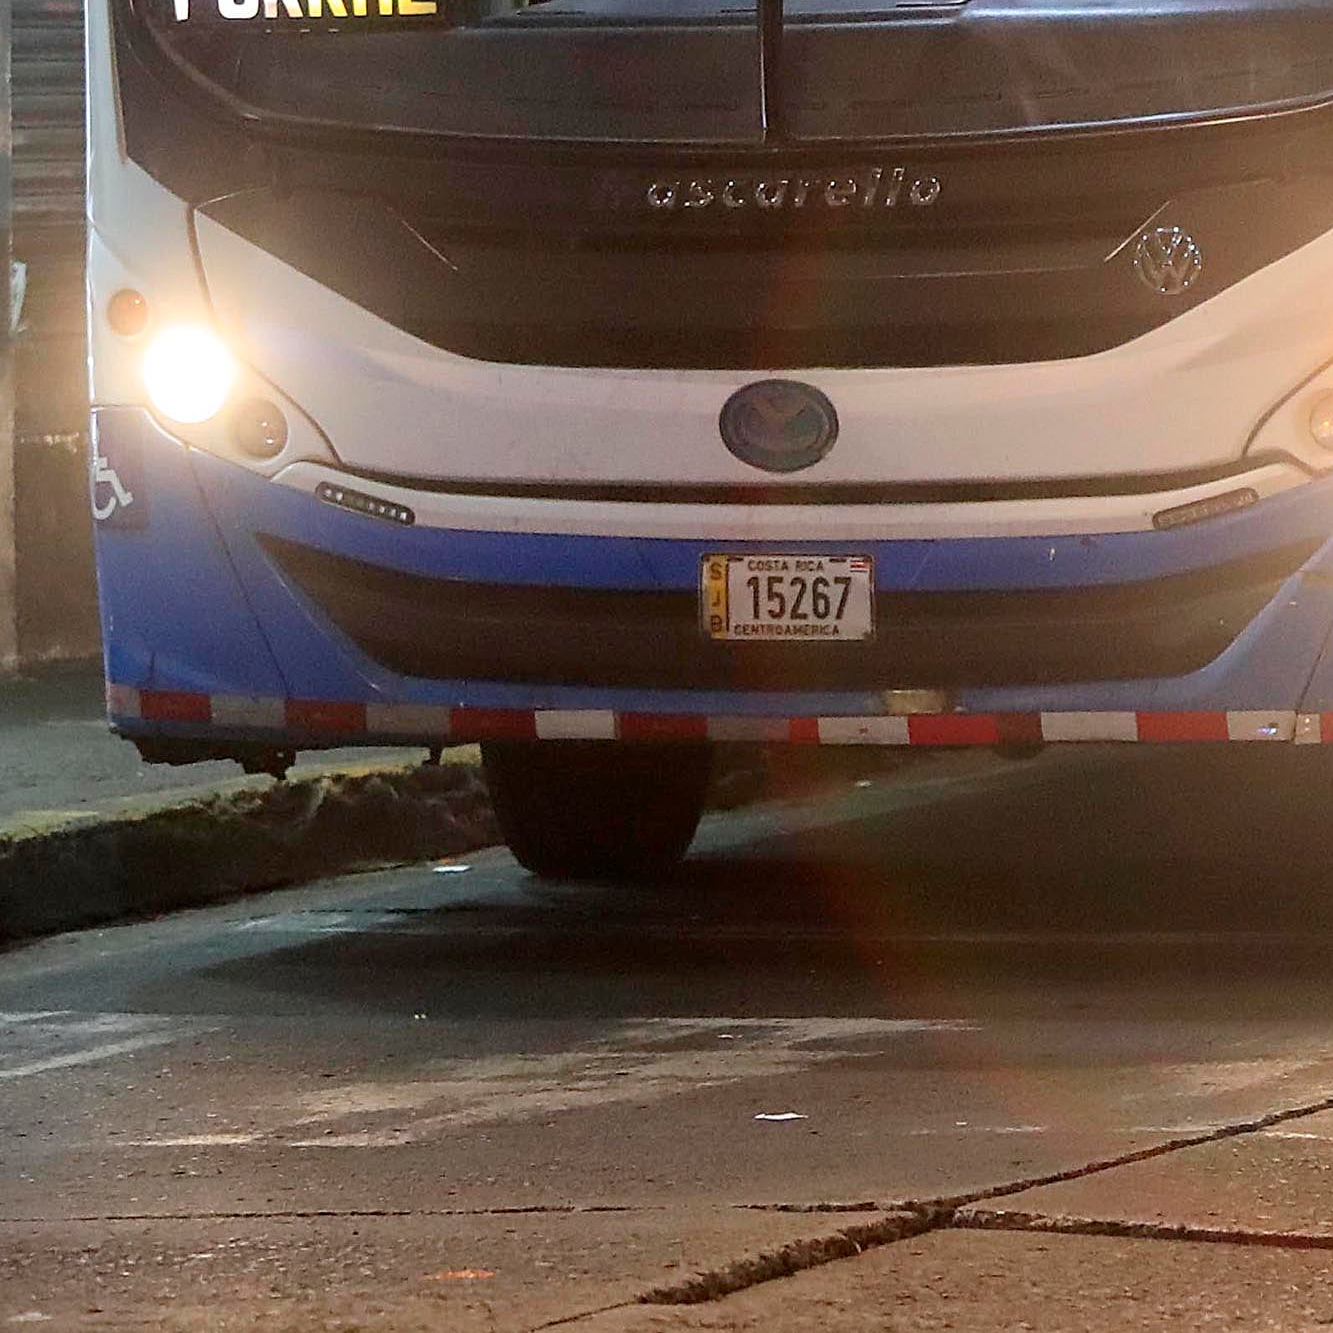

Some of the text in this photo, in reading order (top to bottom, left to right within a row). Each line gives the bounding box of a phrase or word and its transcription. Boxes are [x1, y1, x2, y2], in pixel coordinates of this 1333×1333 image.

[747, 560, 788, 572] COSTA
[746, 576, 852, 620] 15267
[734, 623, 840, 637] CENTROAMERICA
